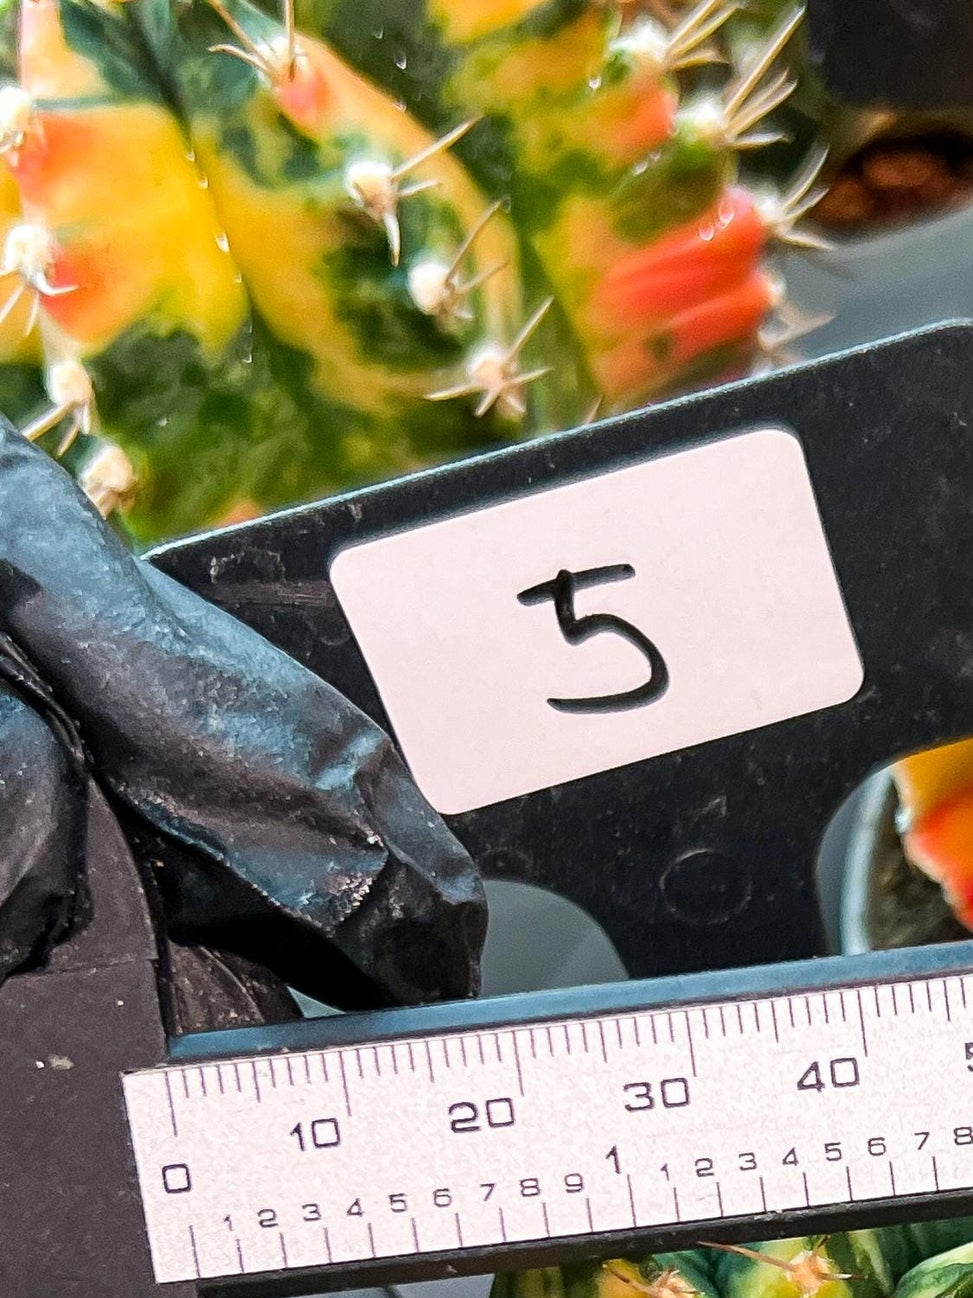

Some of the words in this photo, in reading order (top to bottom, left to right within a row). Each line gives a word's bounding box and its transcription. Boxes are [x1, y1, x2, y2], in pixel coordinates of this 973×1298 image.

[516, 562, 670, 715] 5
[161, 1162, 193, 1195] 0
[289, 1117, 341, 1152] 10
[448, 1097, 516, 1134] 20
[623, 1077, 691, 1113] 30
[796, 1057, 860, 1093] 40
[223, 1214, 234, 1232] 1
[257, 1208, 279, 1229] 2
[301, 1203, 322, 1222] 3
[346, 1198, 364, 1218] 4
[388, 1192, 408, 1214] 5
[432, 1187, 452, 1208] 6
[479, 1182, 496, 1202] 7
[519, 1177, 541, 1198] 8
[563, 1172, 584, 1194] 9
[605, 1145, 622, 1175] 1
[660, 1163, 671, 1181] 1
[694, 1157, 715, 1178] 2
[738, 1151, 758, 1172] 3
[782, 1147, 800, 1167] 4
[823, 1141, 843, 1162] 5
[866, 1136, 887, 1157] 6
[913, 1131, 930, 1151] 7
